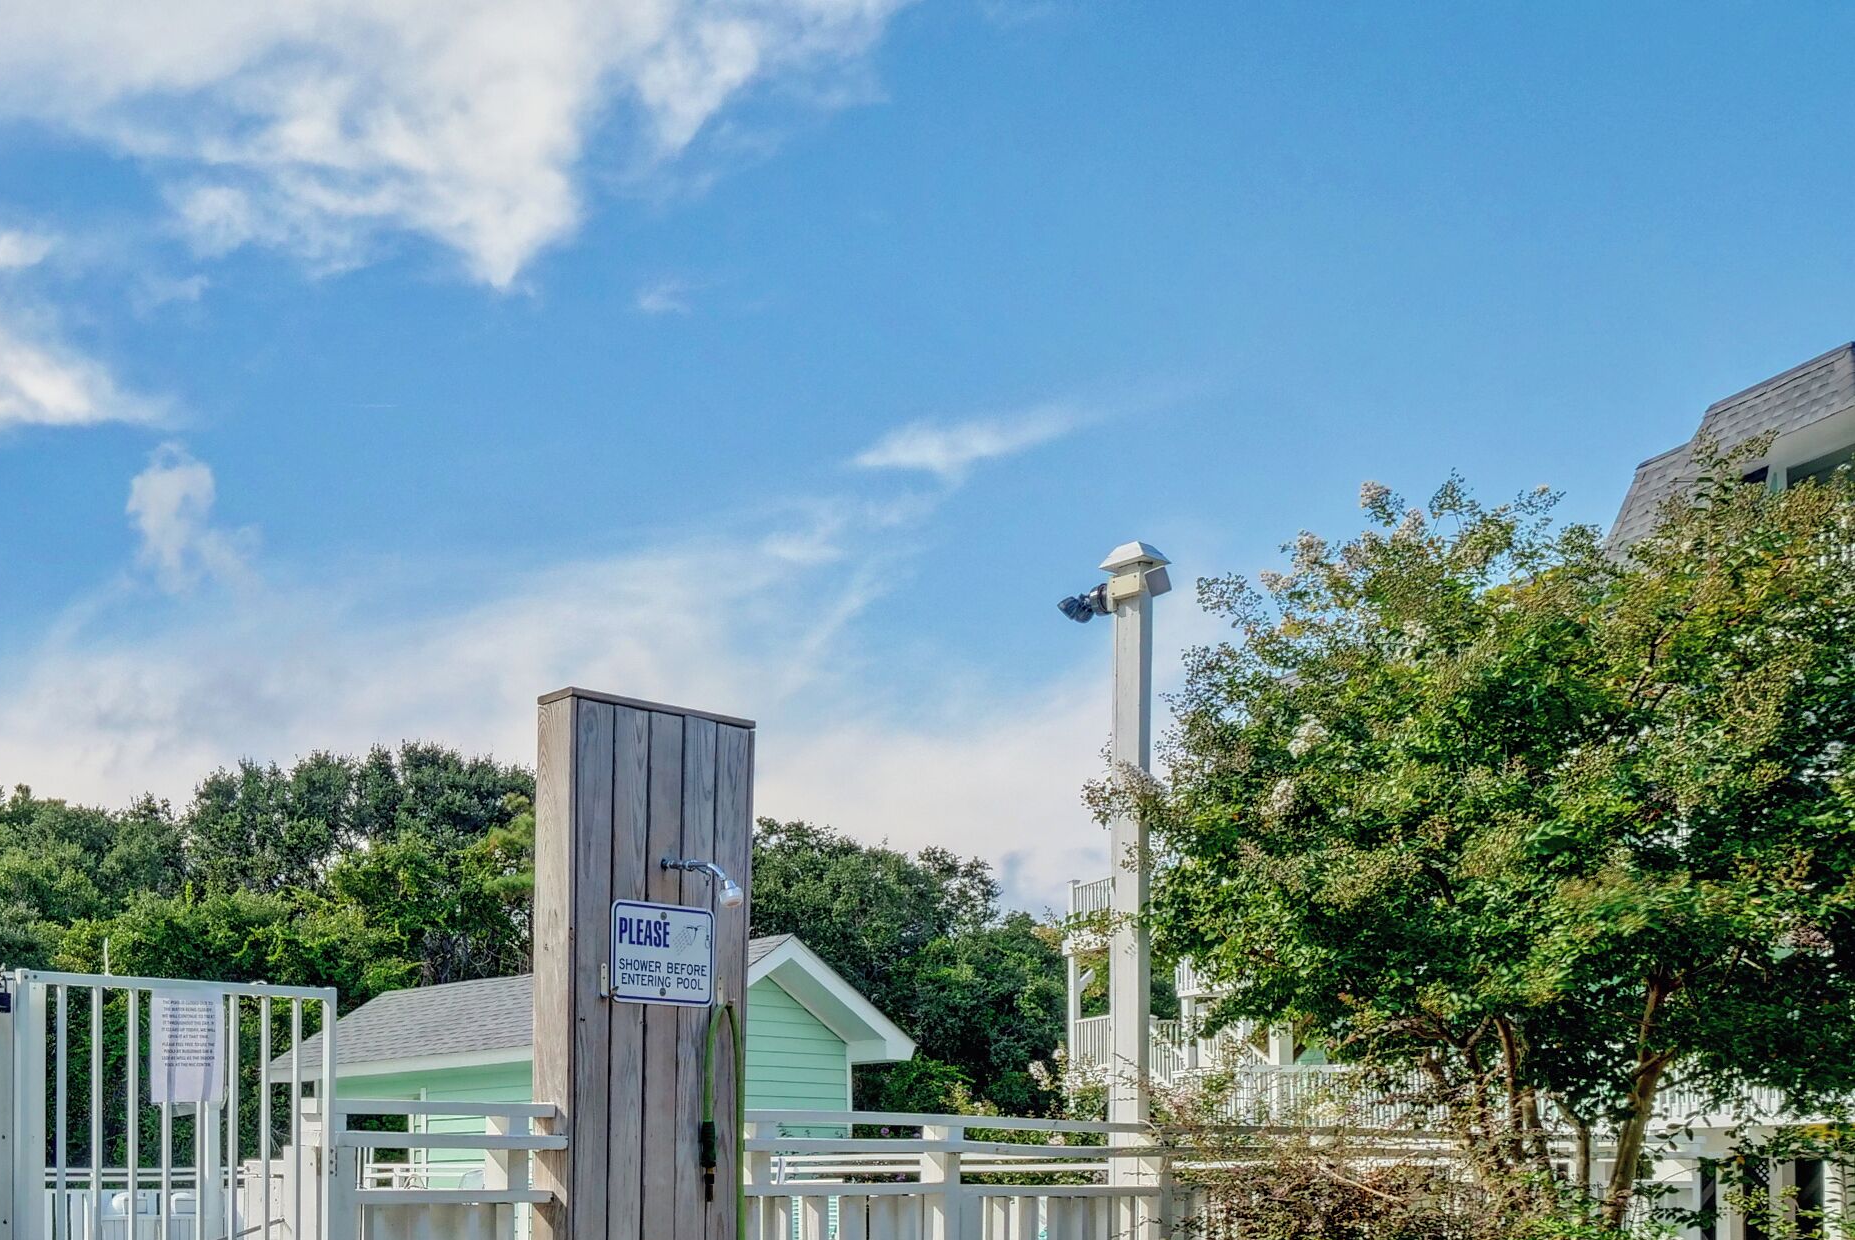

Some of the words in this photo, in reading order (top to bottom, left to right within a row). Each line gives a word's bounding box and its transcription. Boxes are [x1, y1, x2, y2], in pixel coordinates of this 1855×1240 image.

[619, 917, 670, 948] PLEASE
[619, 958, 662, 973] SHOWER
[667, 962, 707, 976] BEFORE
[622, 973, 671, 988] ENTERING
[677, 978, 703, 990] POOL
